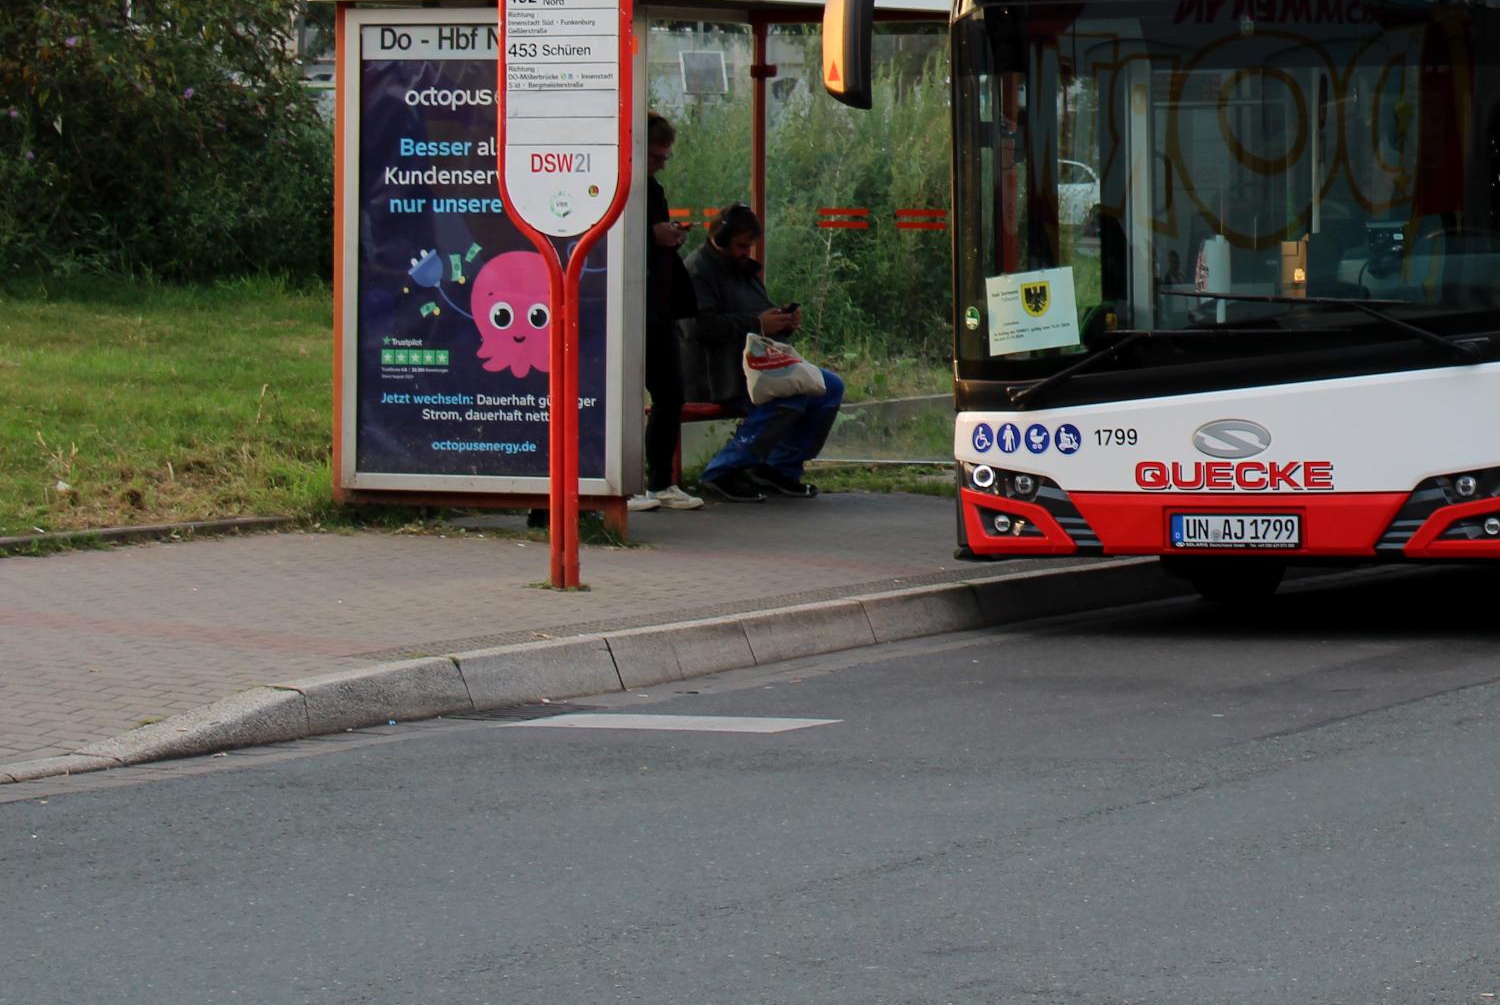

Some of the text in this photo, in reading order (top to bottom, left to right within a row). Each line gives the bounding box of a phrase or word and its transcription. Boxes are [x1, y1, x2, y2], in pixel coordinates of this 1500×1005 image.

[380, 27, 412, 50] Do
[438, 27, 478, 50] Hbf
[487, 27, 499, 50] N
[508, 43, 591, 57] 453 Schüren
[405, 86, 498, 111] octopus
[400, 136, 498, 156] Besser al
[531, 153, 591, 173] DSW21
[389, 198, 502, 213] nur unsere
[392, 338, 422, 347] Trustpilot
[380, 393, 410, 404] Jetzt
[413, 393, 474, 405] wechseln:
[476, 394, 536, 406] Dauerhaft
[422, 408, 463, 422] Strom,
[465, 409, 522, 422] dauerhaft
[1094, 428, 1138, 446] 1799
[431, 439, 537, 454] octopusenergy.de
[1134, 461, 1334, 491] QUECKE
[1186, 518, 1295, 540] UN AJ 1799
